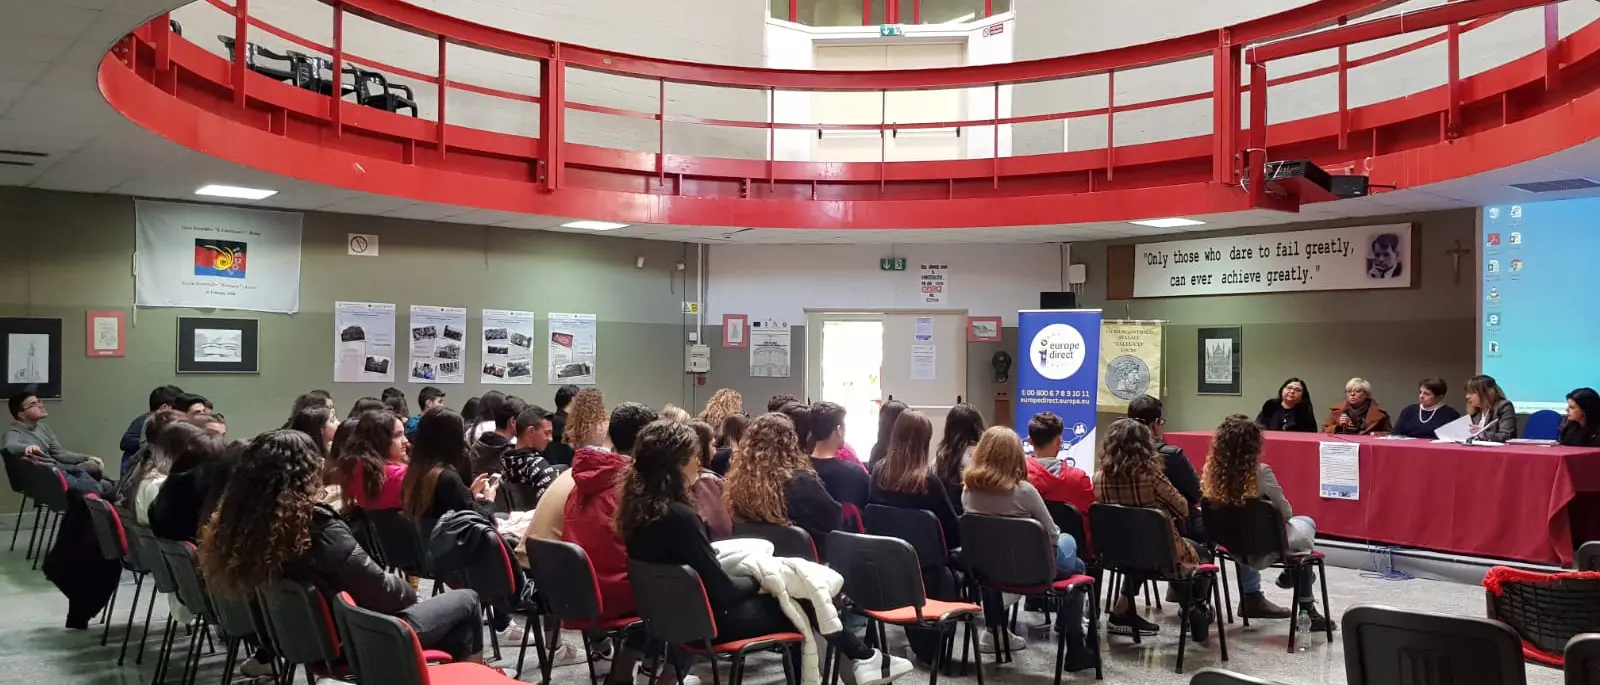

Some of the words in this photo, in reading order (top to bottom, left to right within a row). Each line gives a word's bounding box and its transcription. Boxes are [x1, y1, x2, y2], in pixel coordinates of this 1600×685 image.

[1144, 252, 1168, 268] "Only
[1174, 250, 1200, 264] those
[1204, 247, 1221, 261] who
[1229, 246, 1253, 260] dare
[1259, 245, 1270, 258] to
[1276, 241, 1299, 257] fail
[1305, 238, 1354, 259] greatly,
[1170, 275, 1186, 287] can
[1191, 274, 1213, 286] ever
[1221, 269, 1261, 284] achieve
[1267, 265, 1320, 286] greatly."
[1050, 342, 1080, 351] europe
[1050, 349, 1073, 359] direct
[1072, 390, 1080, 398] 10
[1082, 390, 1090, 398] 11
[1020, 397, 1090, 405] europedirect.europa.eu
